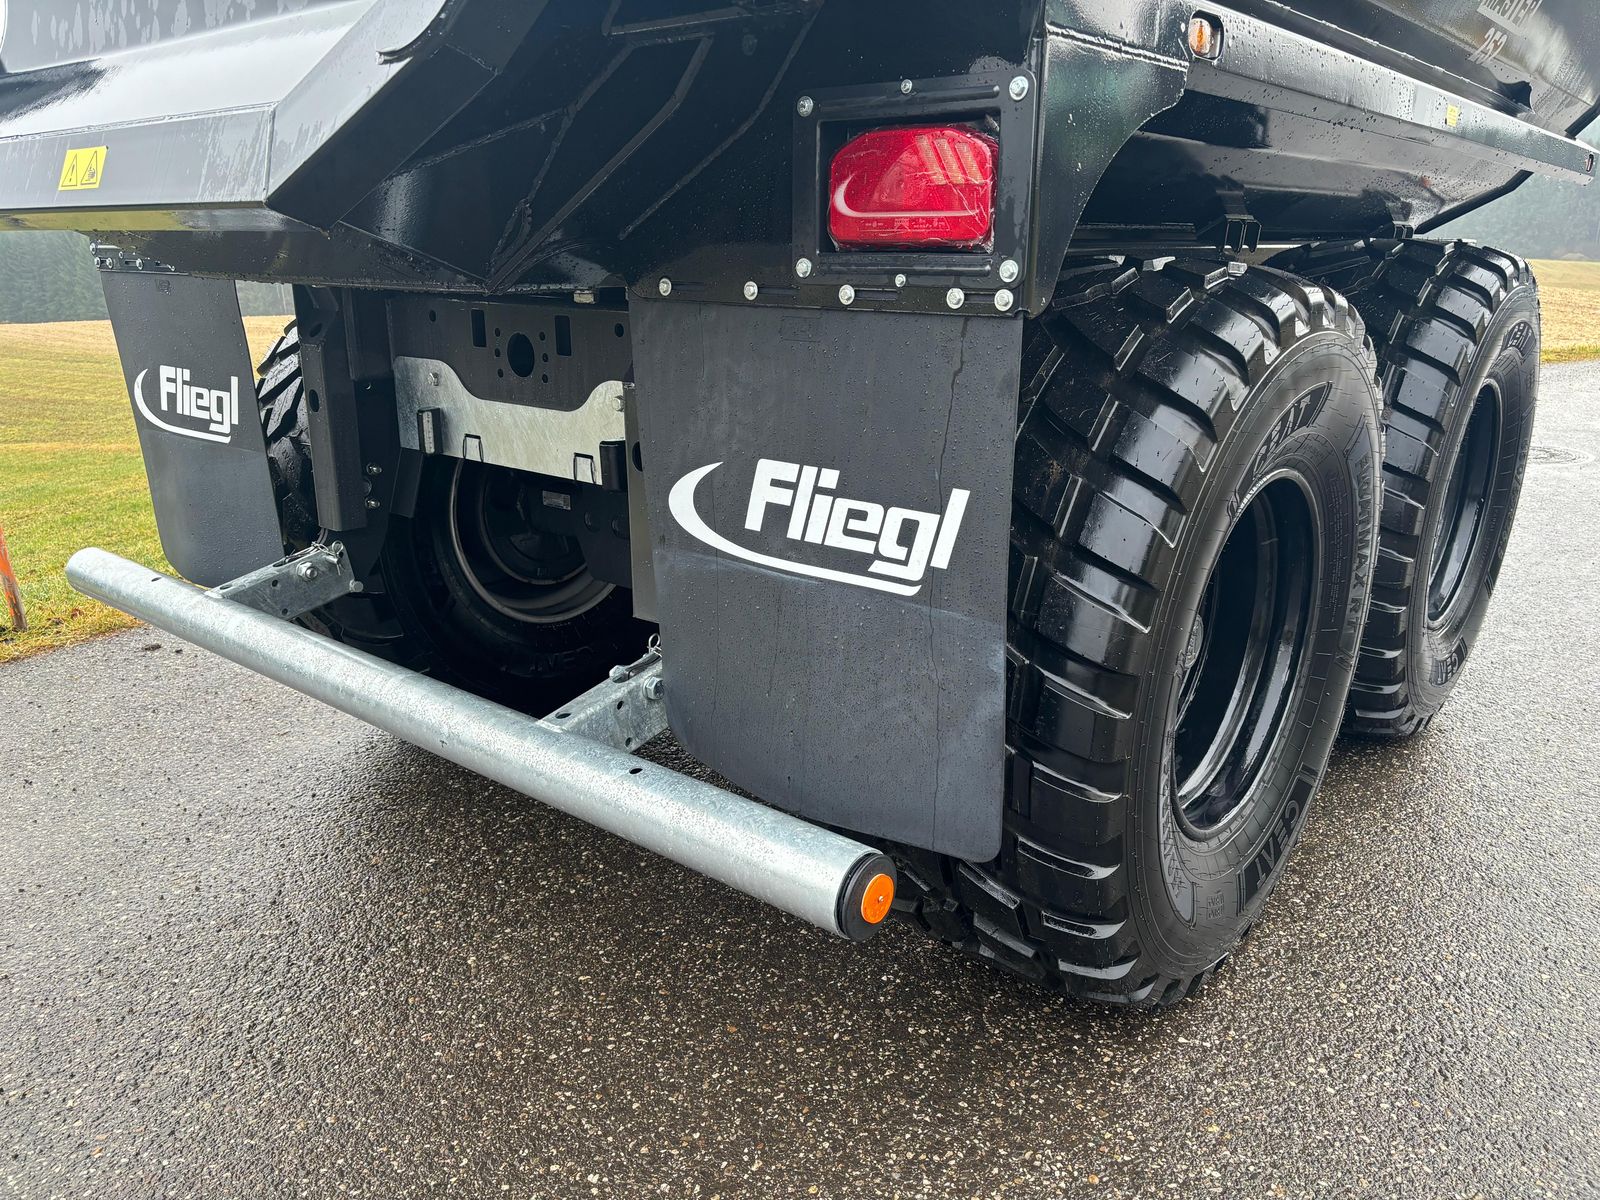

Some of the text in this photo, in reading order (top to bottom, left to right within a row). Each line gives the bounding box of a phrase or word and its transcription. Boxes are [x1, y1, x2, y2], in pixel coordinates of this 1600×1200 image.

[1468, 27, 1508, 66] 252
[160, 365, 239, 434] Fliegl
[744, 458, 971, 581] Fliegl
[1253, 799, 1300, 891] CEAT
